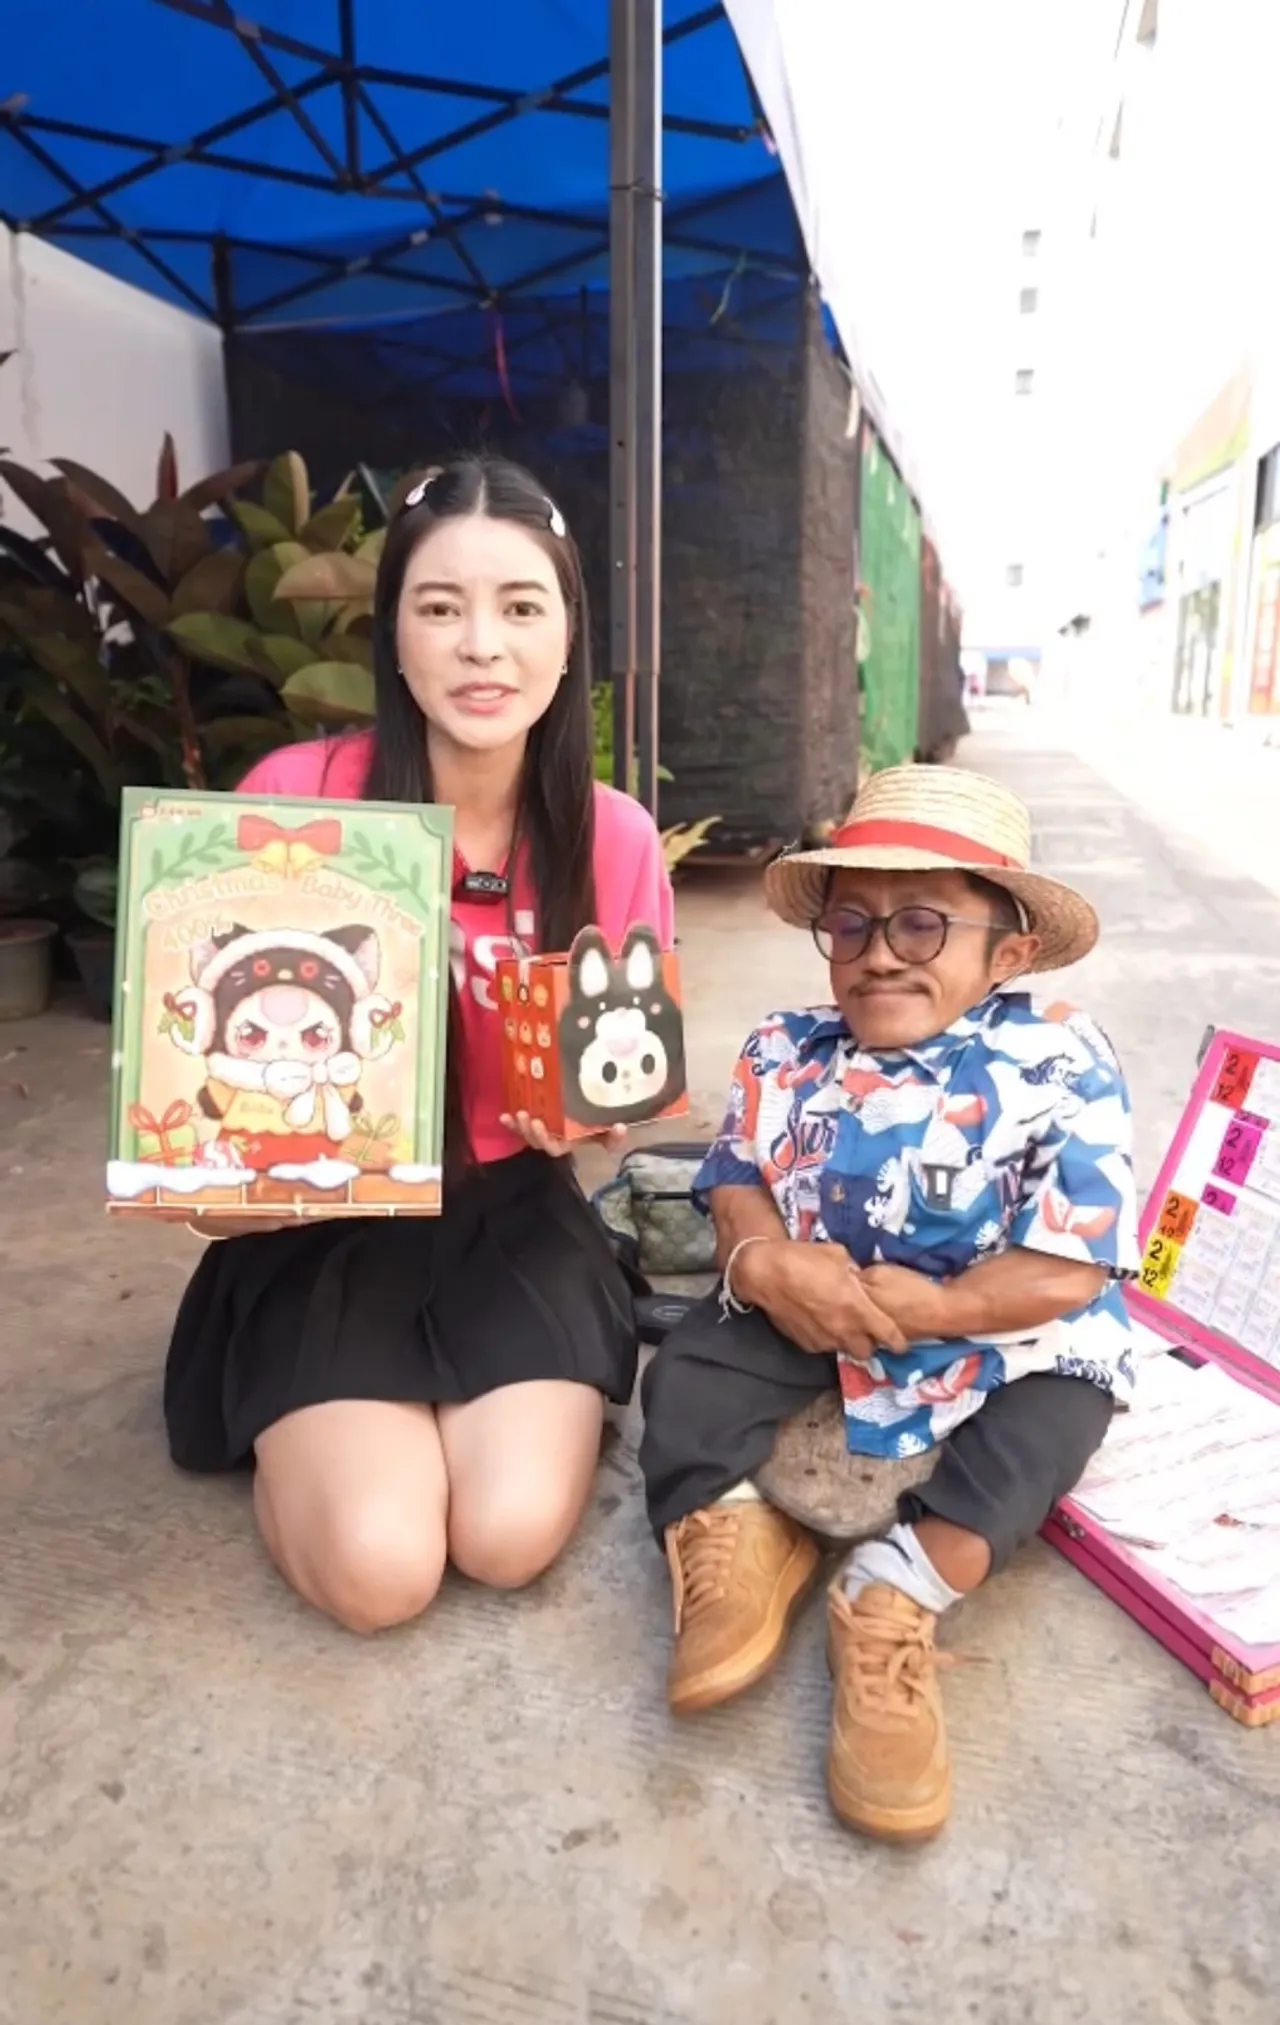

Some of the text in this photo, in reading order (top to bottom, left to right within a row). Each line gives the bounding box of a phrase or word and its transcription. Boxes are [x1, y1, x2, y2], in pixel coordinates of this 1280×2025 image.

[146, 871, 280, 918] Christmas
[301, 874, 364, 911] Baby
[1165, 1196, 1180, 1219] 2
[1149, 1239, 1163, 1261] 2
